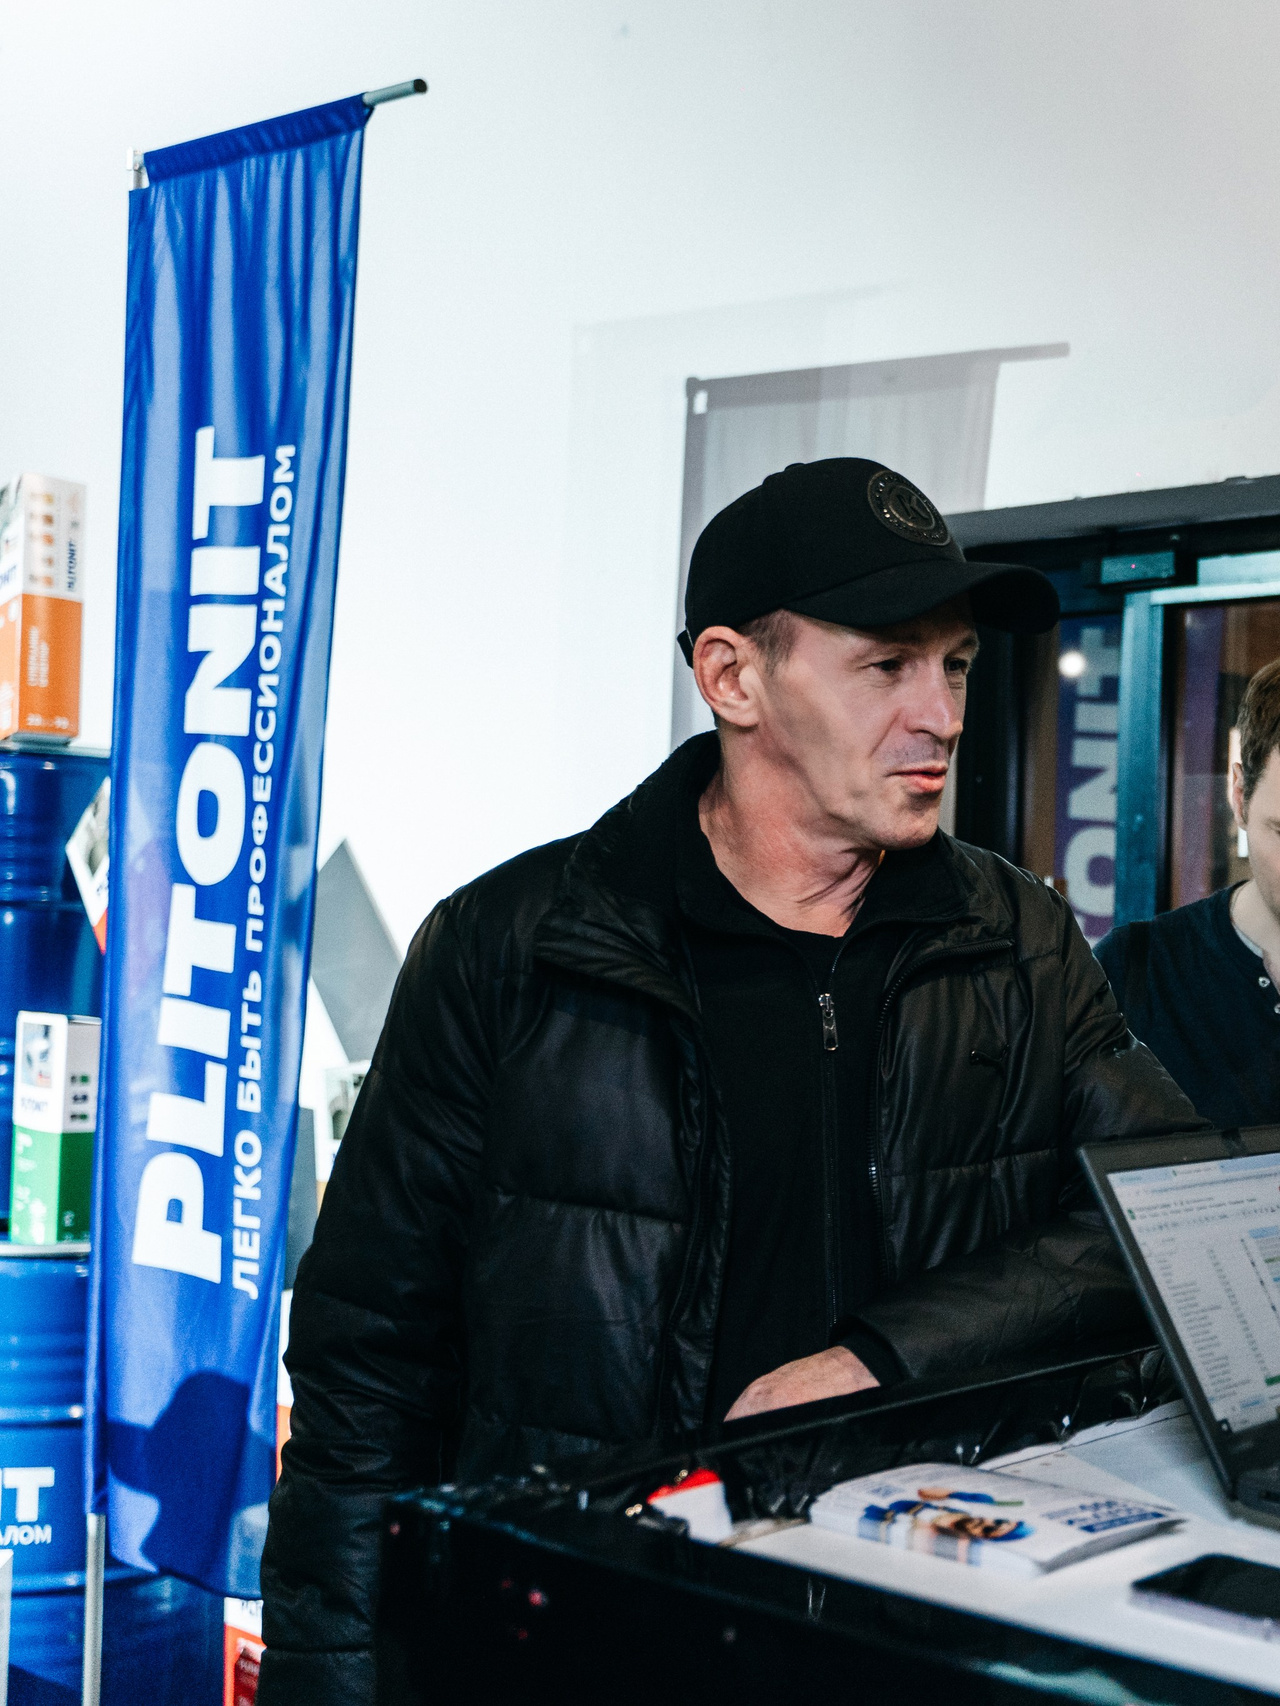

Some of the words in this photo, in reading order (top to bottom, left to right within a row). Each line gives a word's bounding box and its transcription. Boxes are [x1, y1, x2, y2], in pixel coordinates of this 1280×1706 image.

[244, 444, 296, 953] ПРОФЕССИОНАЛОМ
[1063, 626, 1121, 918] ONIT
[132, 426, 266, 1284] PLITONIT
[236, 976, 263, 1114] БЫТЬ
[232, 1129, 263, 1300] ЛЕГКО
[0, 1466, 56, 1523] T
[0, 1524, 53, 1546] ЛОМ
